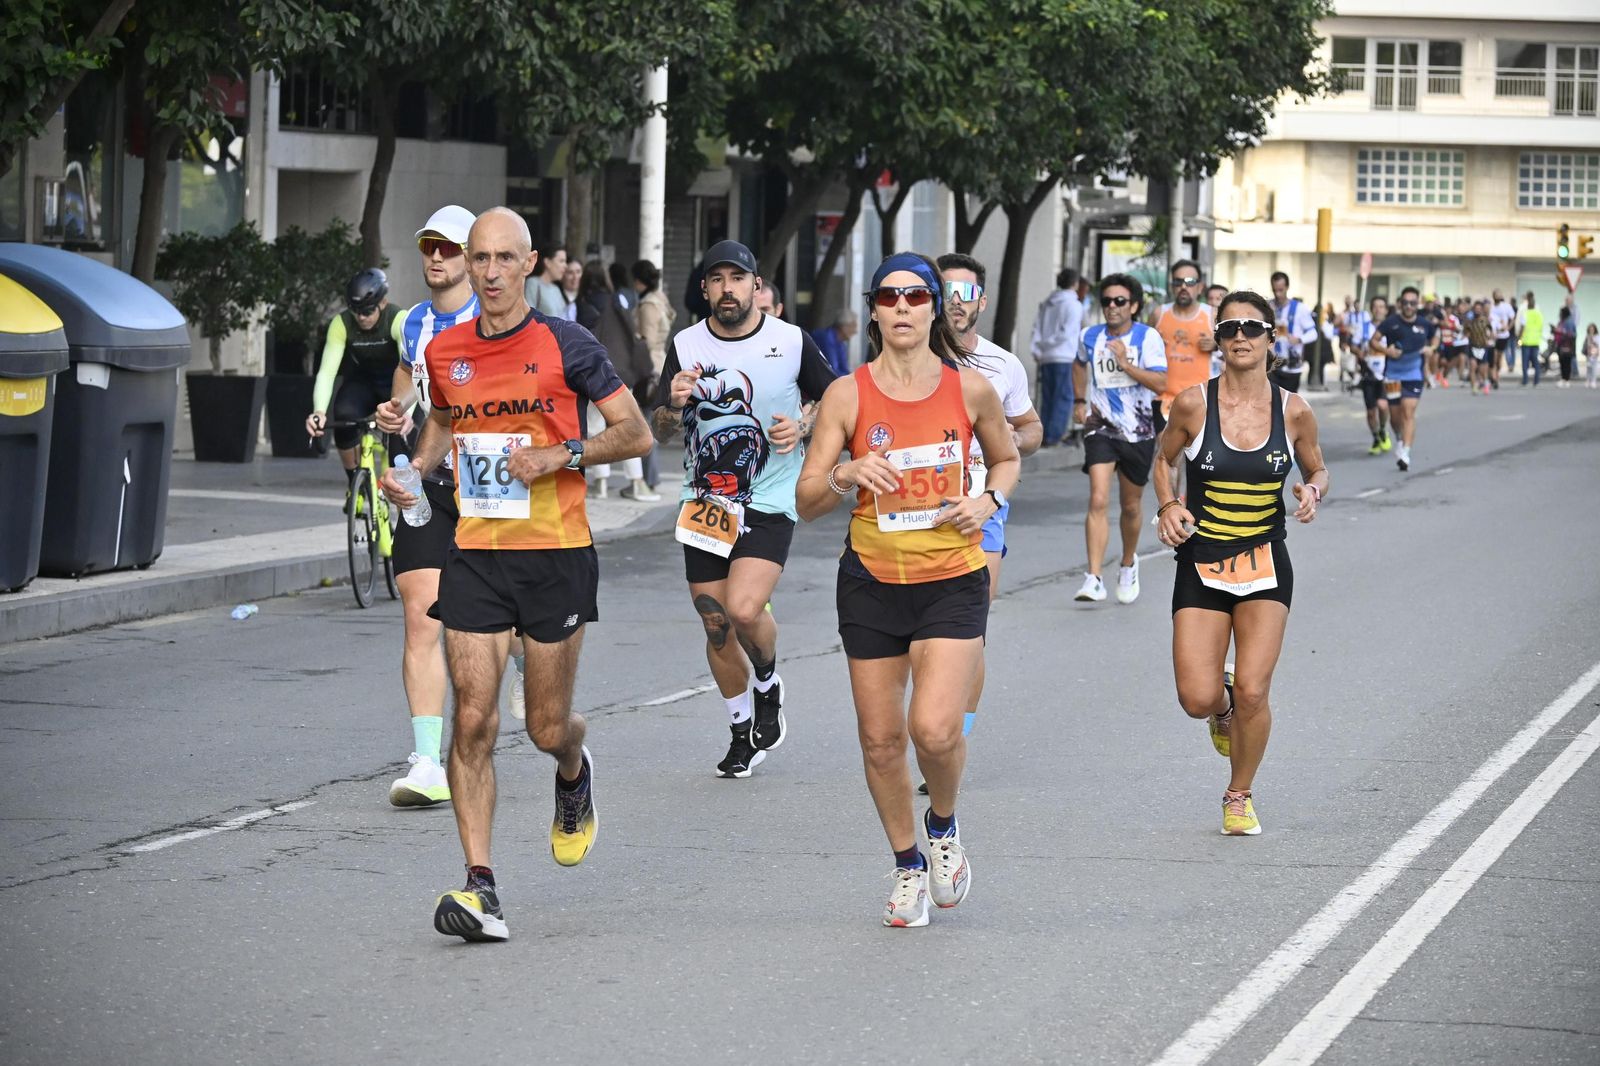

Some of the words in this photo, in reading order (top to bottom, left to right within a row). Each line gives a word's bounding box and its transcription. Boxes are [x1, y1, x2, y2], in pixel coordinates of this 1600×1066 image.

[414, 363, 425, 374] 2K
[482, 398, 555, 418] CAMAS
[506, 437, 524, 449] 2K
[938, 444, 956, 459] 2K
[467, 456, 514, 486] 126
[690, 499, 730, 533] 266
